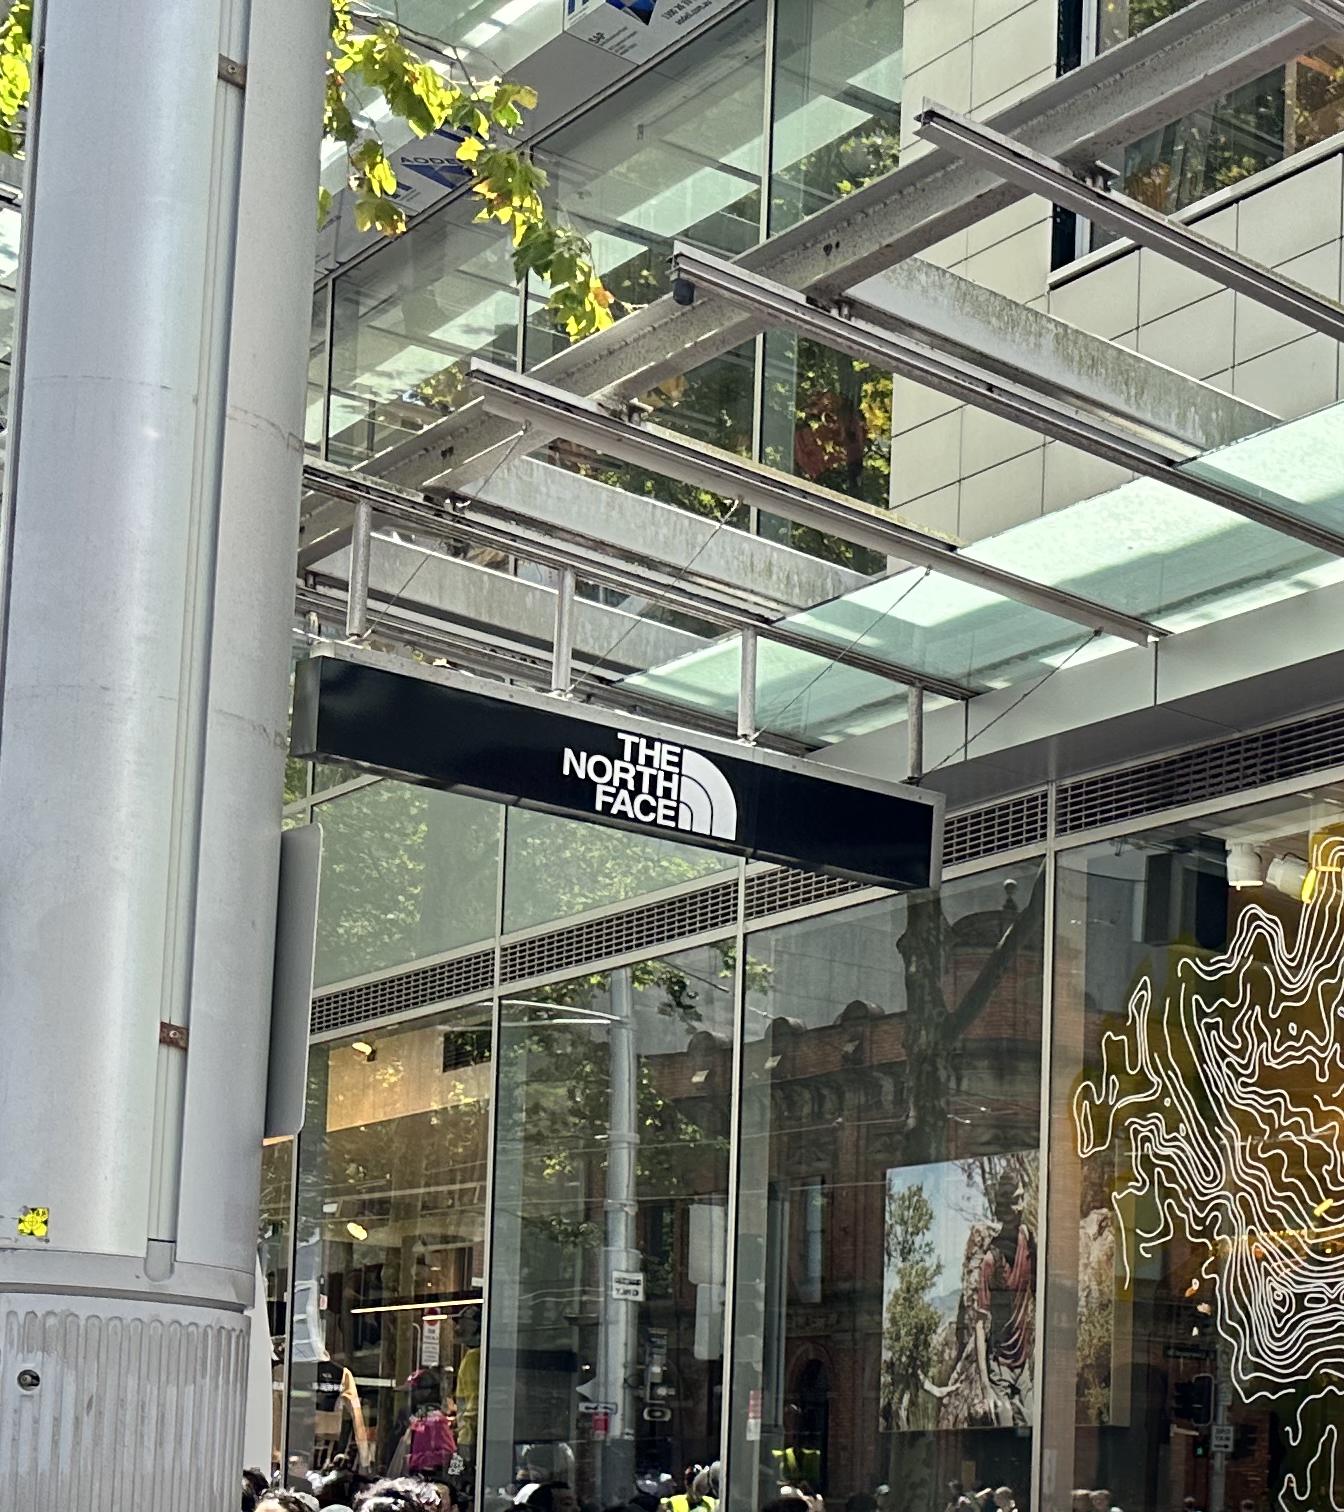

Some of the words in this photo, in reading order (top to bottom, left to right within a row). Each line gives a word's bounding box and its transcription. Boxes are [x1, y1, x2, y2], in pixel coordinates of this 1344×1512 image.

[400, 156, 461, 166] AODE
[562, 747, 679, 800] NORTH
[617, 732, 682, 774] THE
[595, 784, 677, 828] FACE
